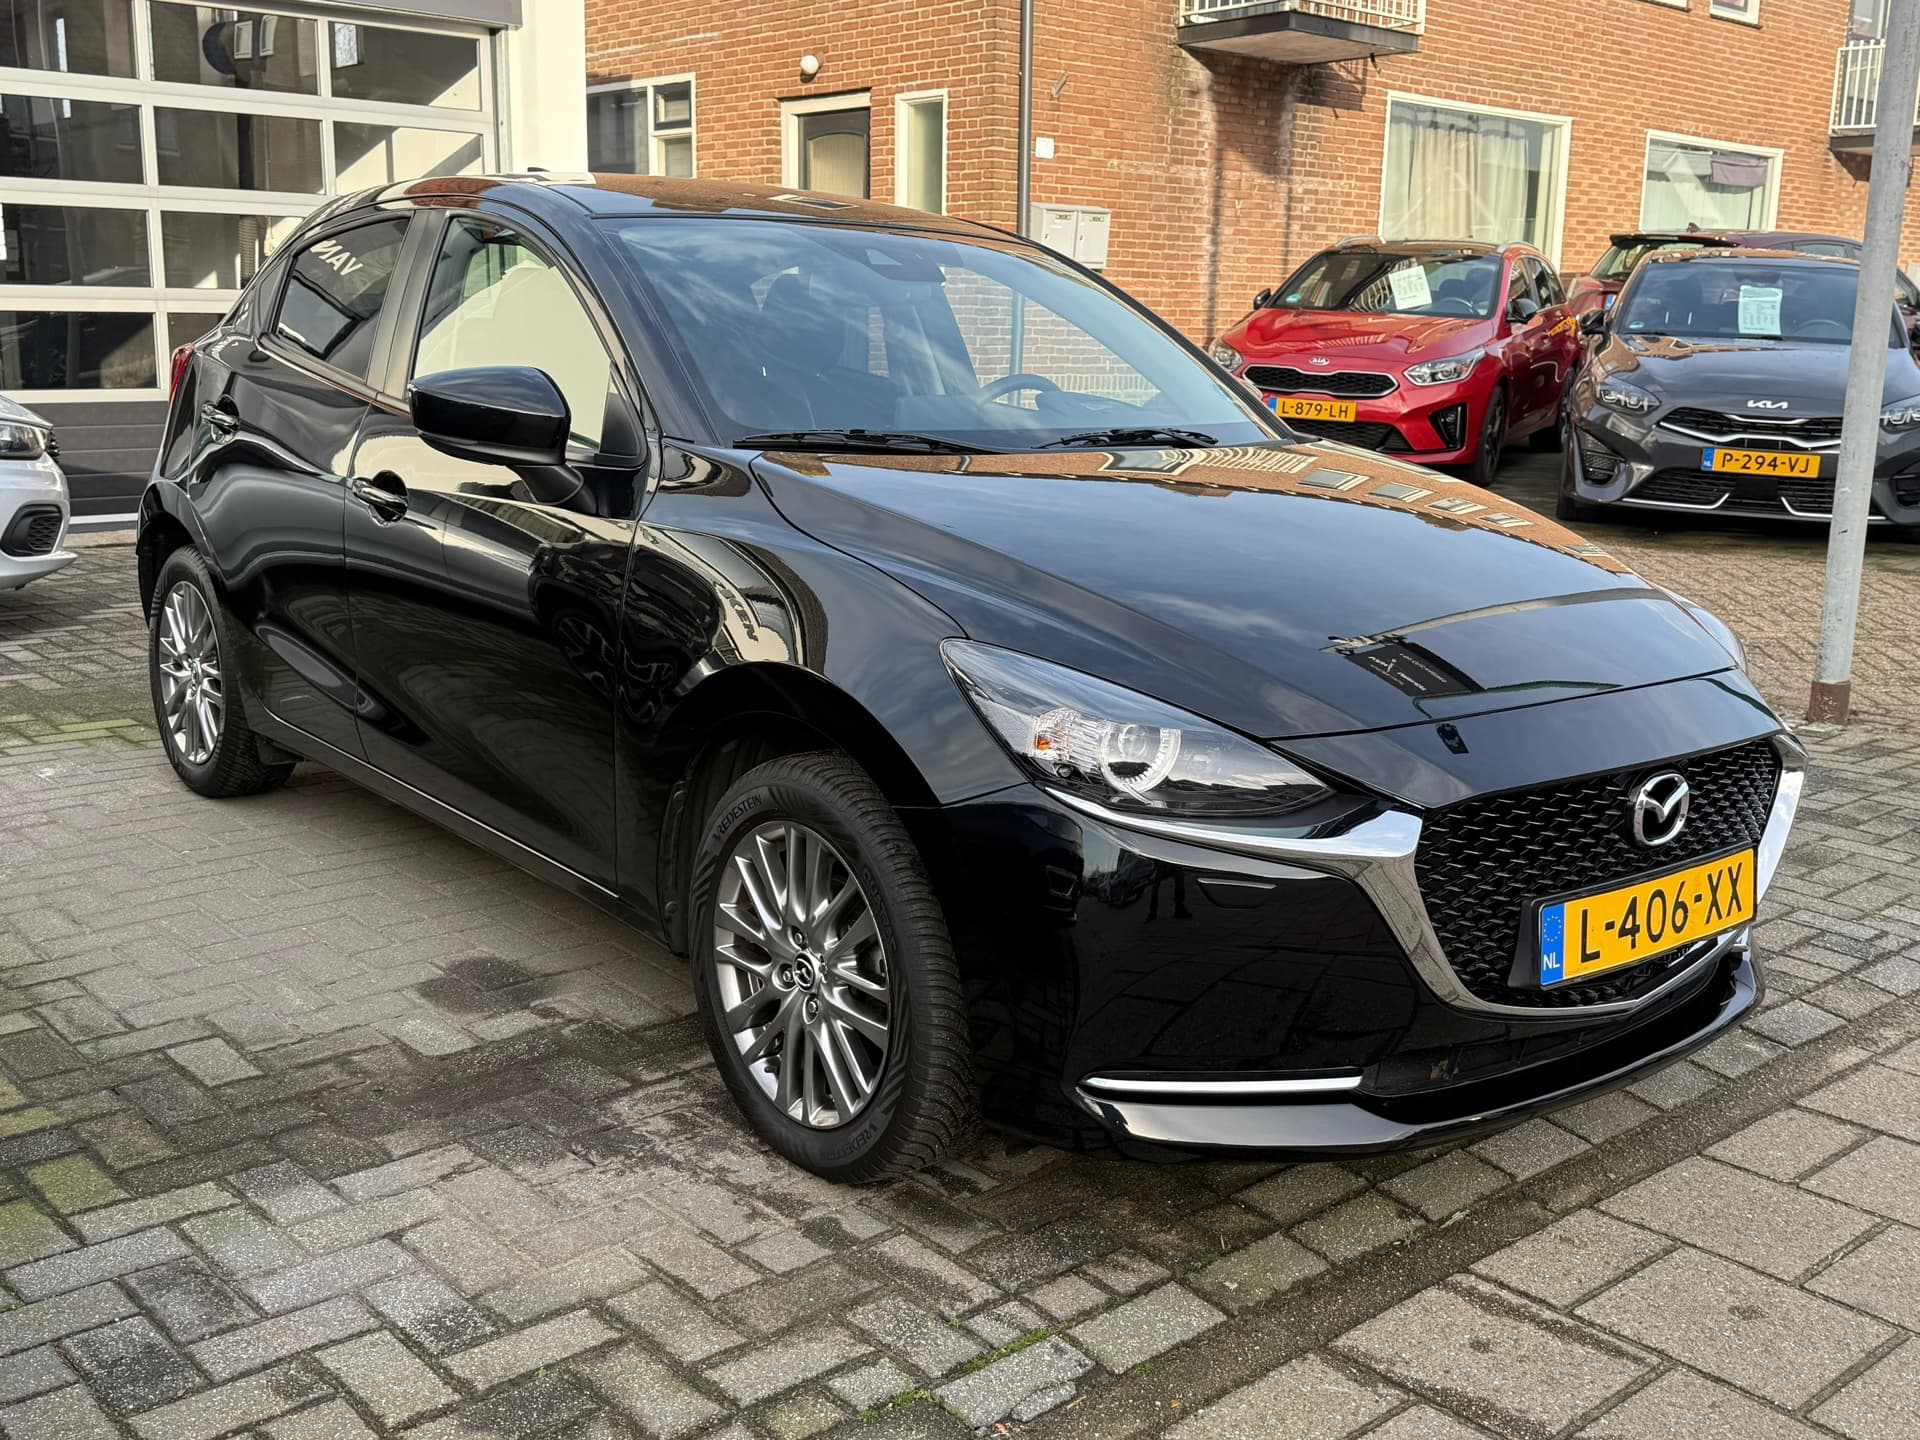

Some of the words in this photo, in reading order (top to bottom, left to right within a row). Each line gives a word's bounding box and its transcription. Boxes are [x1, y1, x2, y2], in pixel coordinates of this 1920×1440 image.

[1309, 357, 1330, 366] KIA
[1281, 401, 1349, 419] L-879-LH
[1721, 452, 1811, 474] P-294-VJ
[1580, 862, 1743, 963] L-406-XX
[1543, 951, 1561, 971] NL
